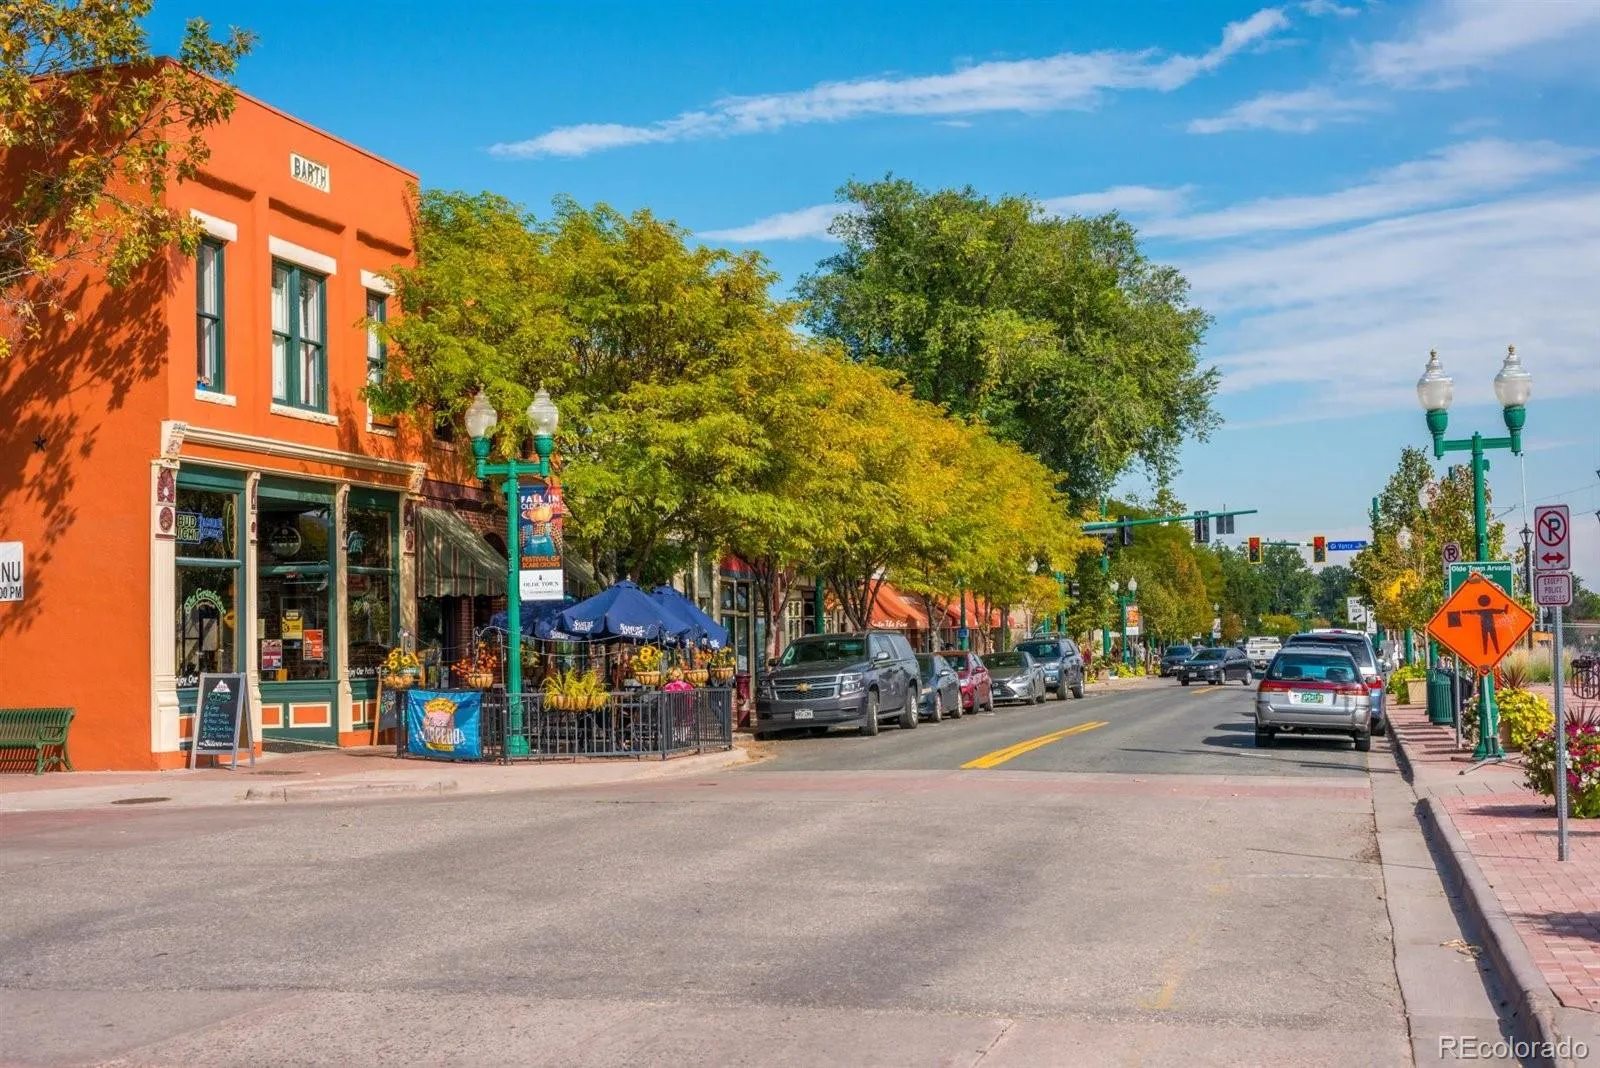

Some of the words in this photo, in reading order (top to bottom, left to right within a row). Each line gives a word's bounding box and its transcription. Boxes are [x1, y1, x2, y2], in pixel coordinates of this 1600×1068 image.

[294, 156, 327, 189] BARTH
[521, 495, 543, 503] FALL
[549, 494, 560, 503] IN
[521, 502, 539, 510] OLDE
[177, 514, 197, 528] BUD
[177, 528, 199, 540] IGHT
[1, 561, 20, 582] NU
[1468, 565, 1486, 573] Town
[1543, 577, 1562, 585] EXCEPT
[10, 586, 22, 598] PM
[189, 674, 199, 684] Our
